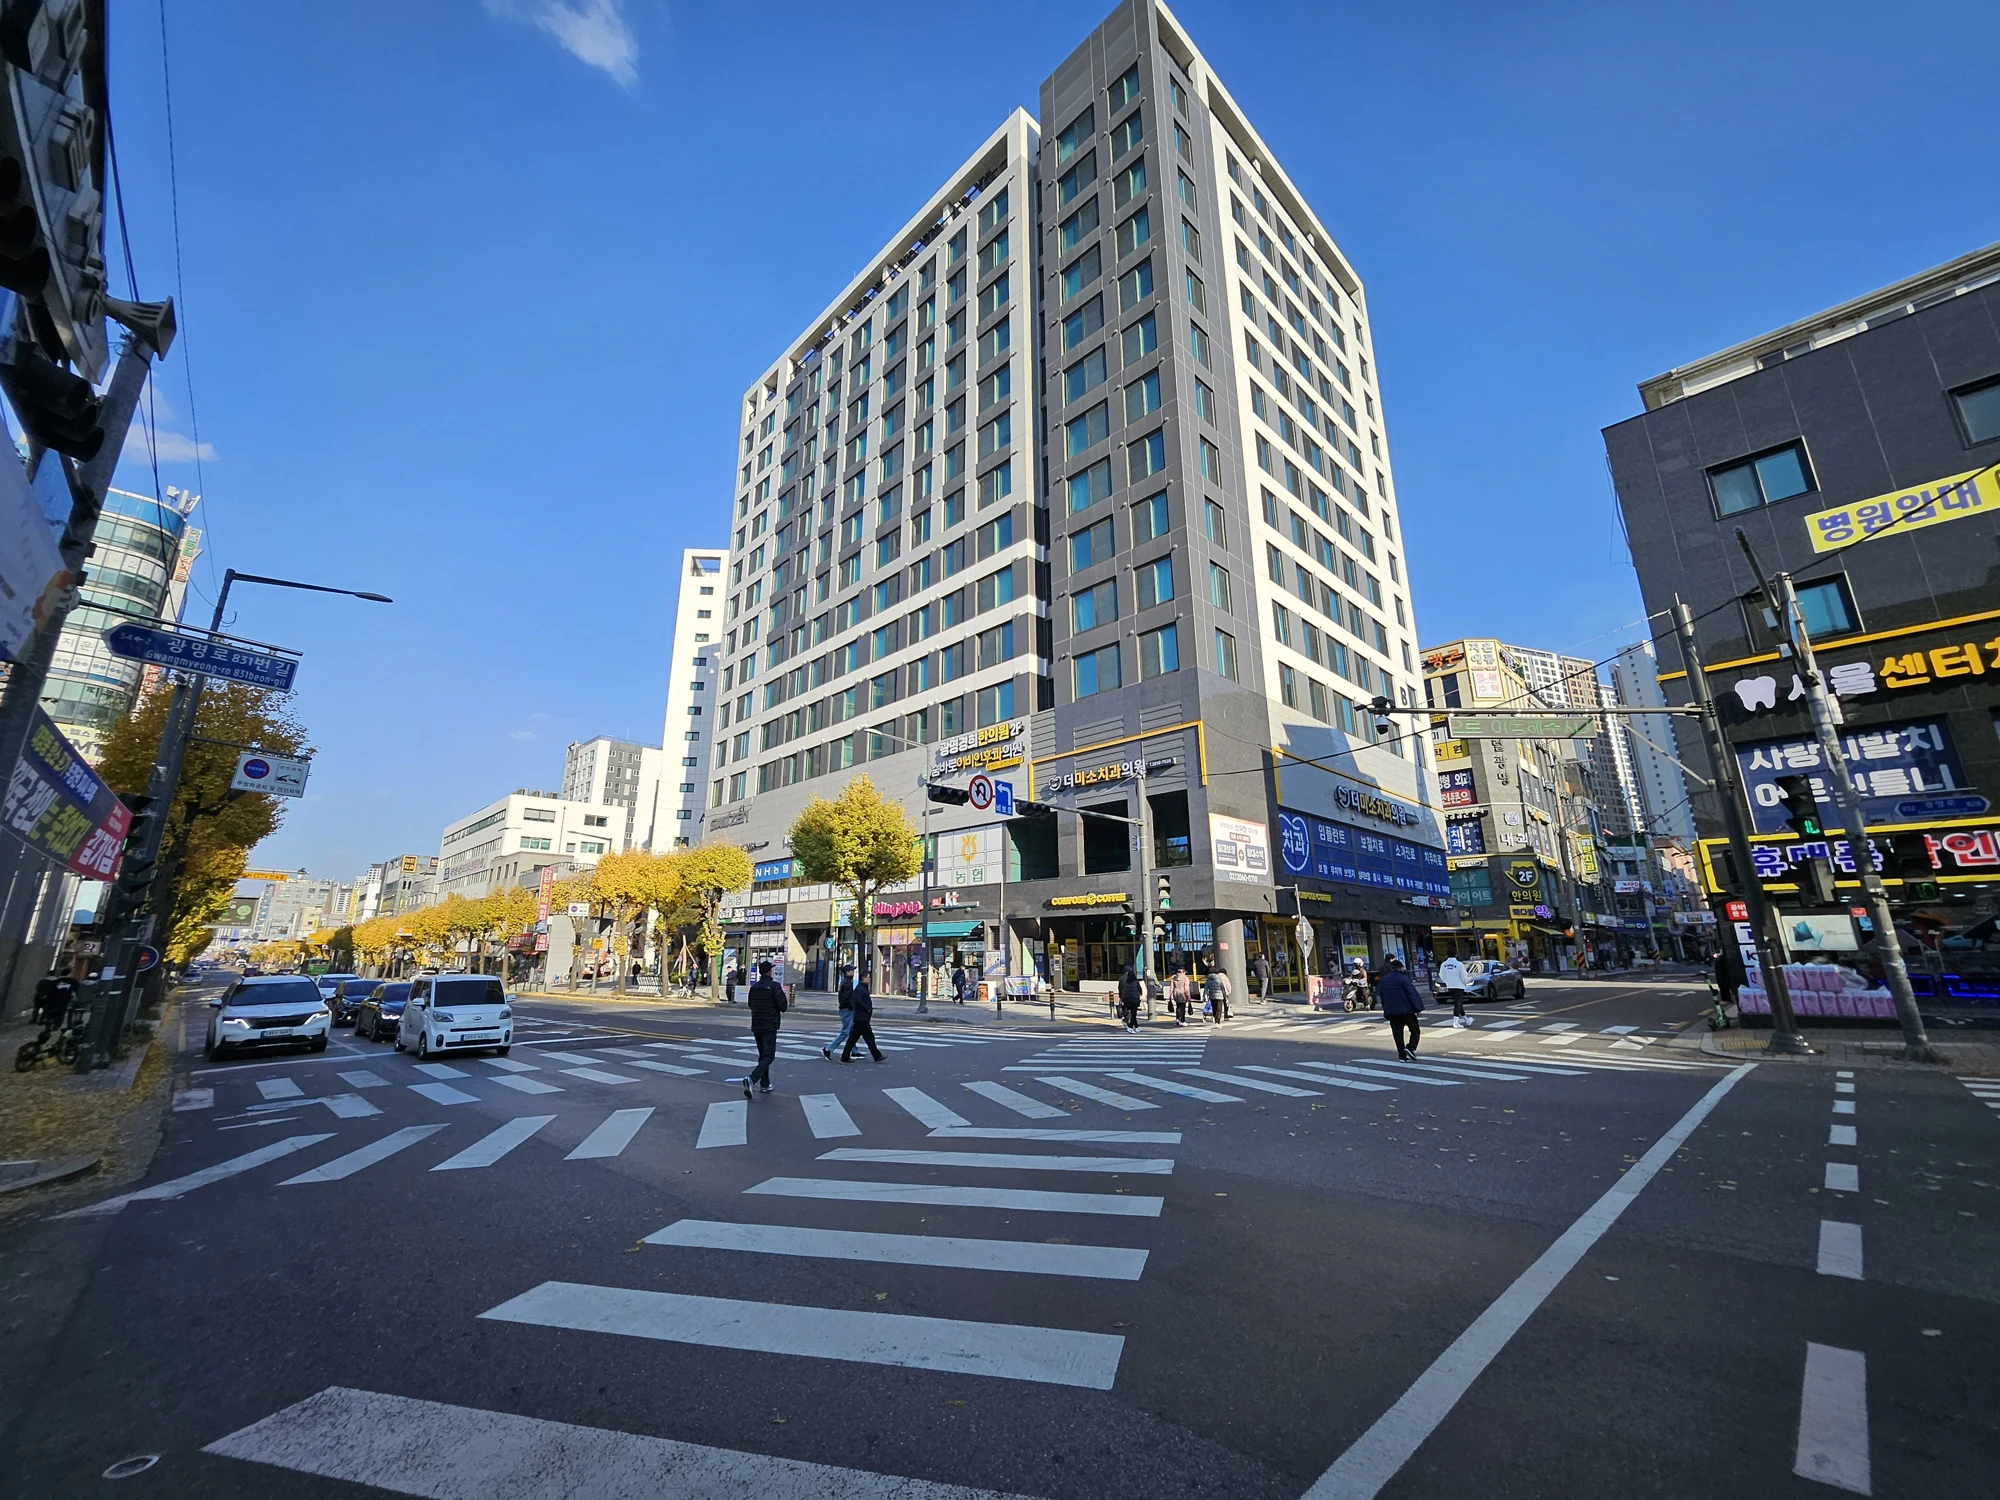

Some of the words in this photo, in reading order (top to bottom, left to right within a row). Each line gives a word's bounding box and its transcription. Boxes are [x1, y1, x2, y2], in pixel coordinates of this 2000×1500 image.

[1818, 479, 1982, 542] 병원임대
[167, 637, 228, 661] 광명로
[232, 653, 290, 677] 831번길
[146, 650, 231, 676] Gwangmyeong-ro
[233, 669, 286, 687] 831beon-gil
[1063, 759, 1146, 787] 더미소치과의원
[1351, 790, 1406, 826] 더미소치과의원
[1282, 828, 1305, 857] 치과
[1319, 824, 1346, 844] 임플란트
[1500, 833, 1528, 847] 내과
[78, 828, 121, 874] 김기남
[755, 863, 789, 877] NH농협
[955, 867, 983, 884] 농협
[1518, 871, 1533, 882] 2F
[945, 891, 959, 906] kt
[1452, 890, 1492, 903] 다이어트
[1511, 890, 1542, 902] 한의원
